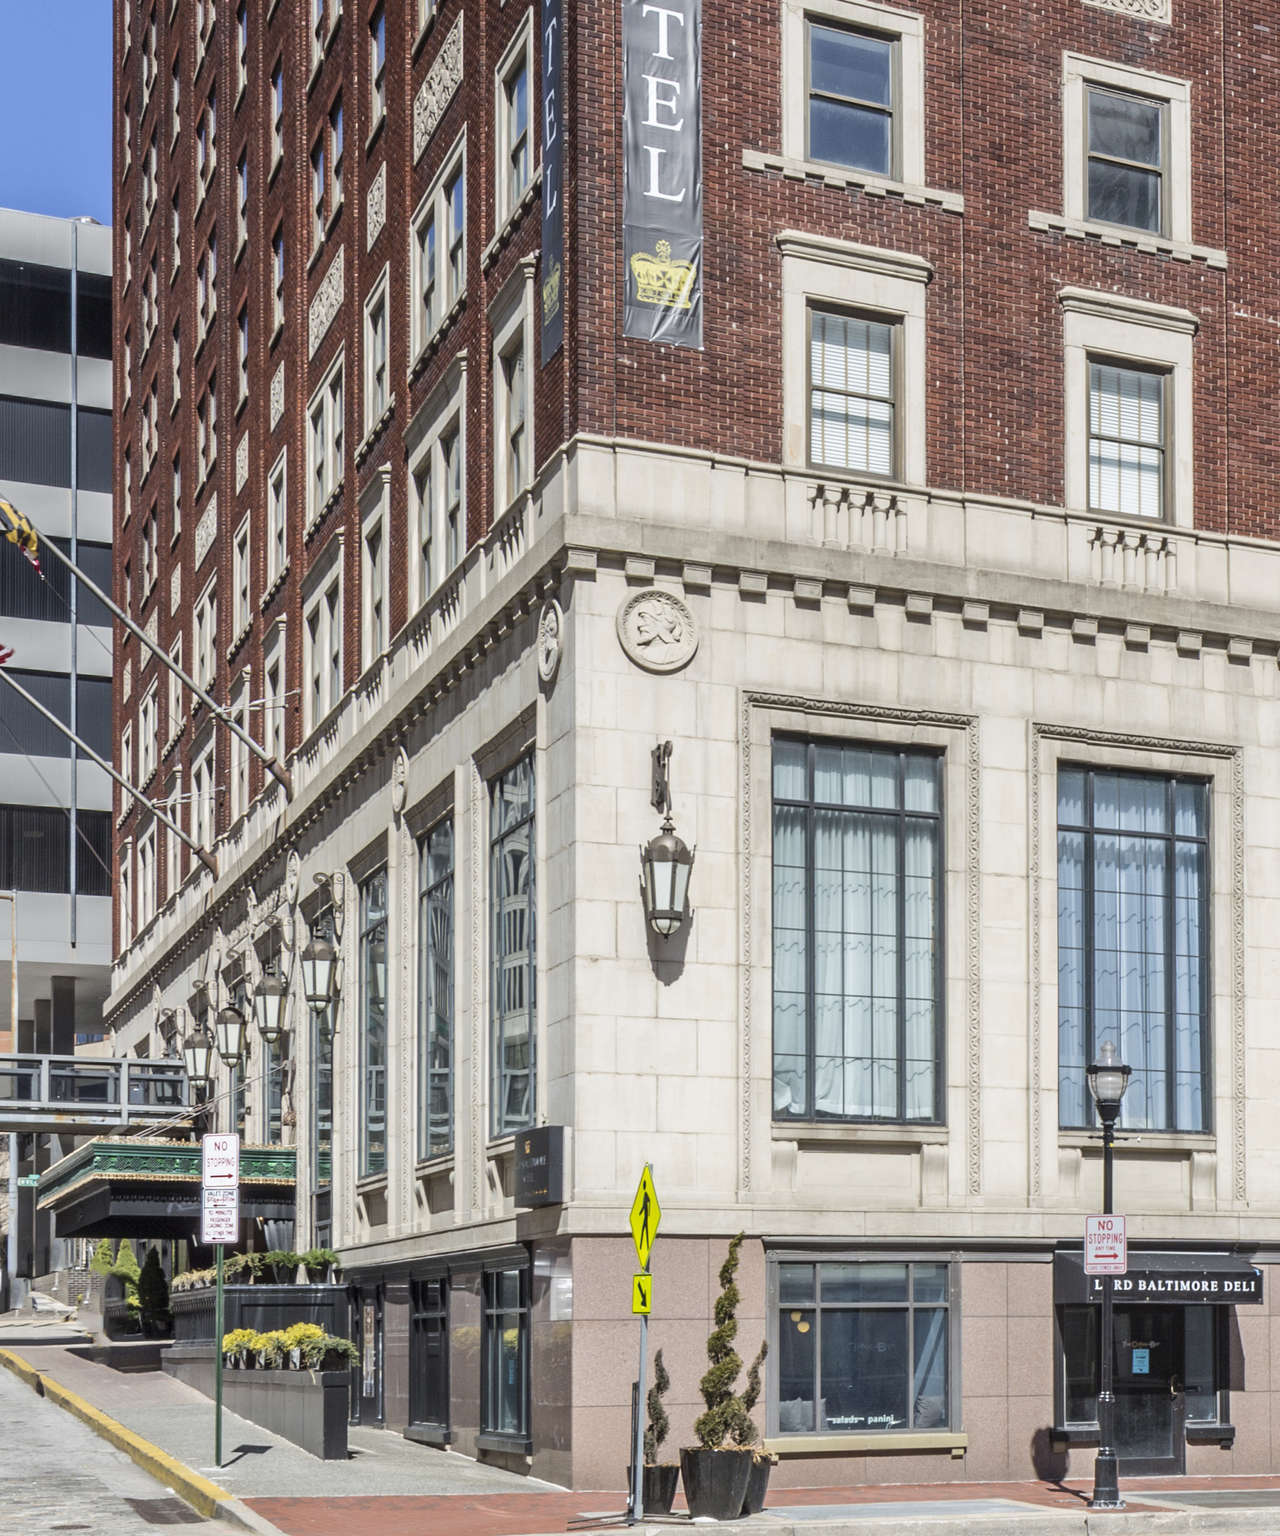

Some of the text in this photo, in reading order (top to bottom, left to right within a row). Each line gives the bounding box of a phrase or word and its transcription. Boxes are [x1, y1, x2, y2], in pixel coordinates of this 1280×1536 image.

[641, 4, 686, 202] TEL
[545, 0, 557, 220] TEL
[214, 1140, 228, 1151] NO
[1097, 1220, 1114, 1231] NO
[1088, 1233, 1123, 1244] STOPPING
[1094, 1279, 1255, 1292] LRD BALTIMORE DELI
[832, 1414, 894, 1424] salads panini
